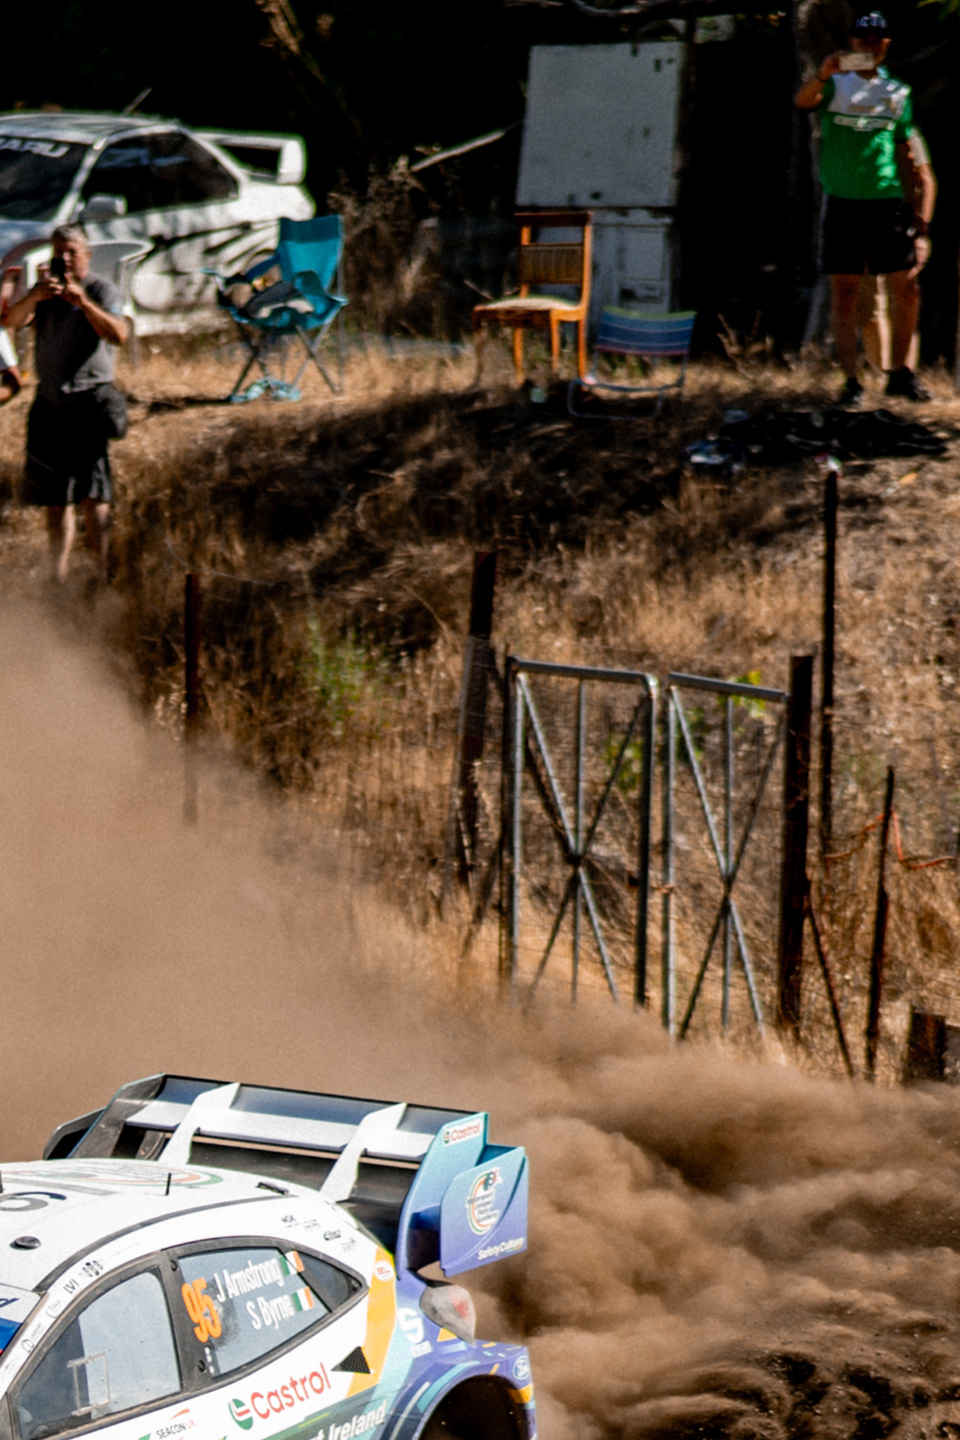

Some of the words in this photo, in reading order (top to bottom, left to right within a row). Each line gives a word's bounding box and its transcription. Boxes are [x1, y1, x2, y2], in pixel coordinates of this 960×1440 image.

[451, 1123, 481, 1142] Castrol
[213, 1273, 227, 1302] J
[222, 1257, 285, 1298] Armstrong
[181, 1277, 222, 1343] 95
[246, 1301, 262, 1330] S
[257, 1295, 295, 1330] Byrne
[250, 1362, 332, 1420] Castrol
